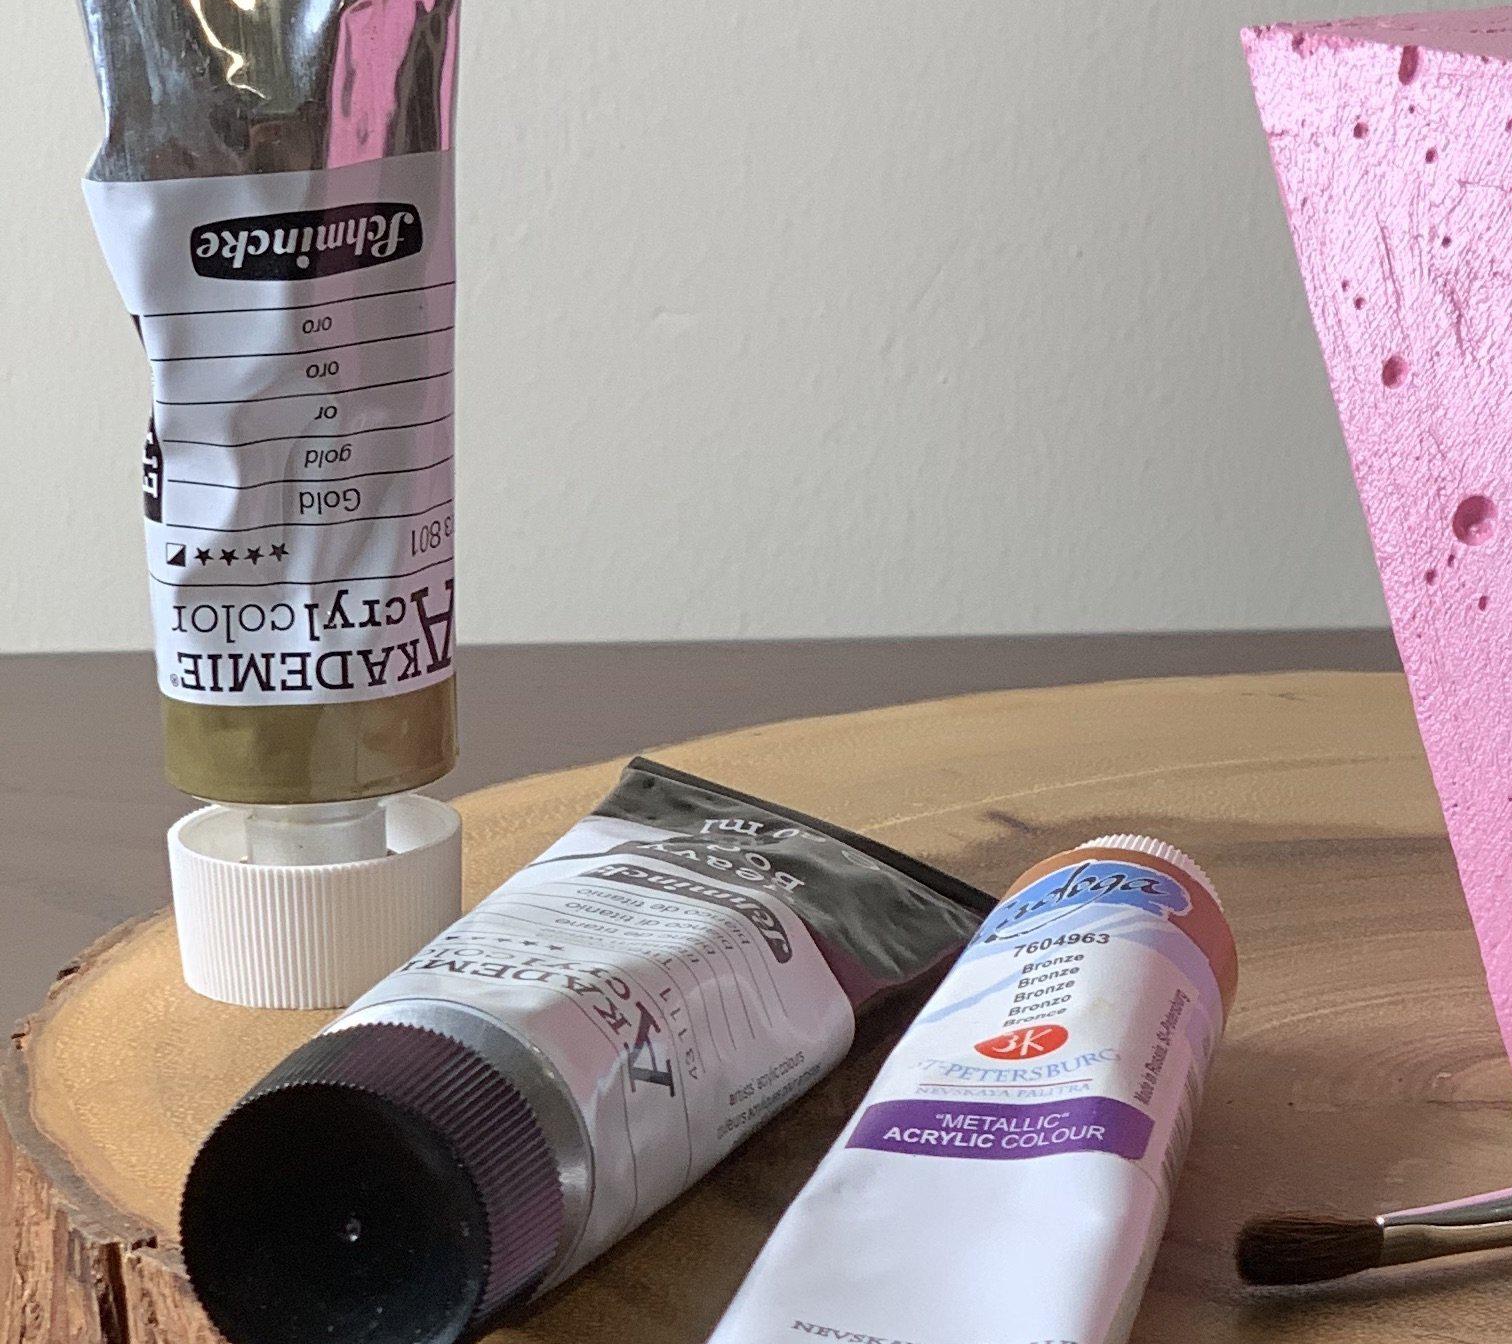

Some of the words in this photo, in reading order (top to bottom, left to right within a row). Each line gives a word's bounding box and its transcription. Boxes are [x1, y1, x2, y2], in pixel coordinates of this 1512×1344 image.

[195, 210, 416, 269] Schmincke
[302, 315, 333, 335] oro
[305, 359, 340, 379] oro
[314, 404, 338, 421] or
[303, 443, 352, 468] gold
[299, 487, 361, 515] Gold
[178, 578, 455, 693] AKADEMIE
[564, 901, 635, 923] titanio
[1012, 932, 1111, 959] 7604963
[1021, 953, 1086, 975] Bronze
[1017, 966, 1081, 990] Bronze
[1013, 979, 1076, 1004] Bronze
[1002, 1007, 1068, 1028] Bronce
[1007, 994, 1073, 1018] Bronzo
[882, 1126, 994, 1148] ACRYLIC
[1000, 1125, 1107, 1150] COLOUR
